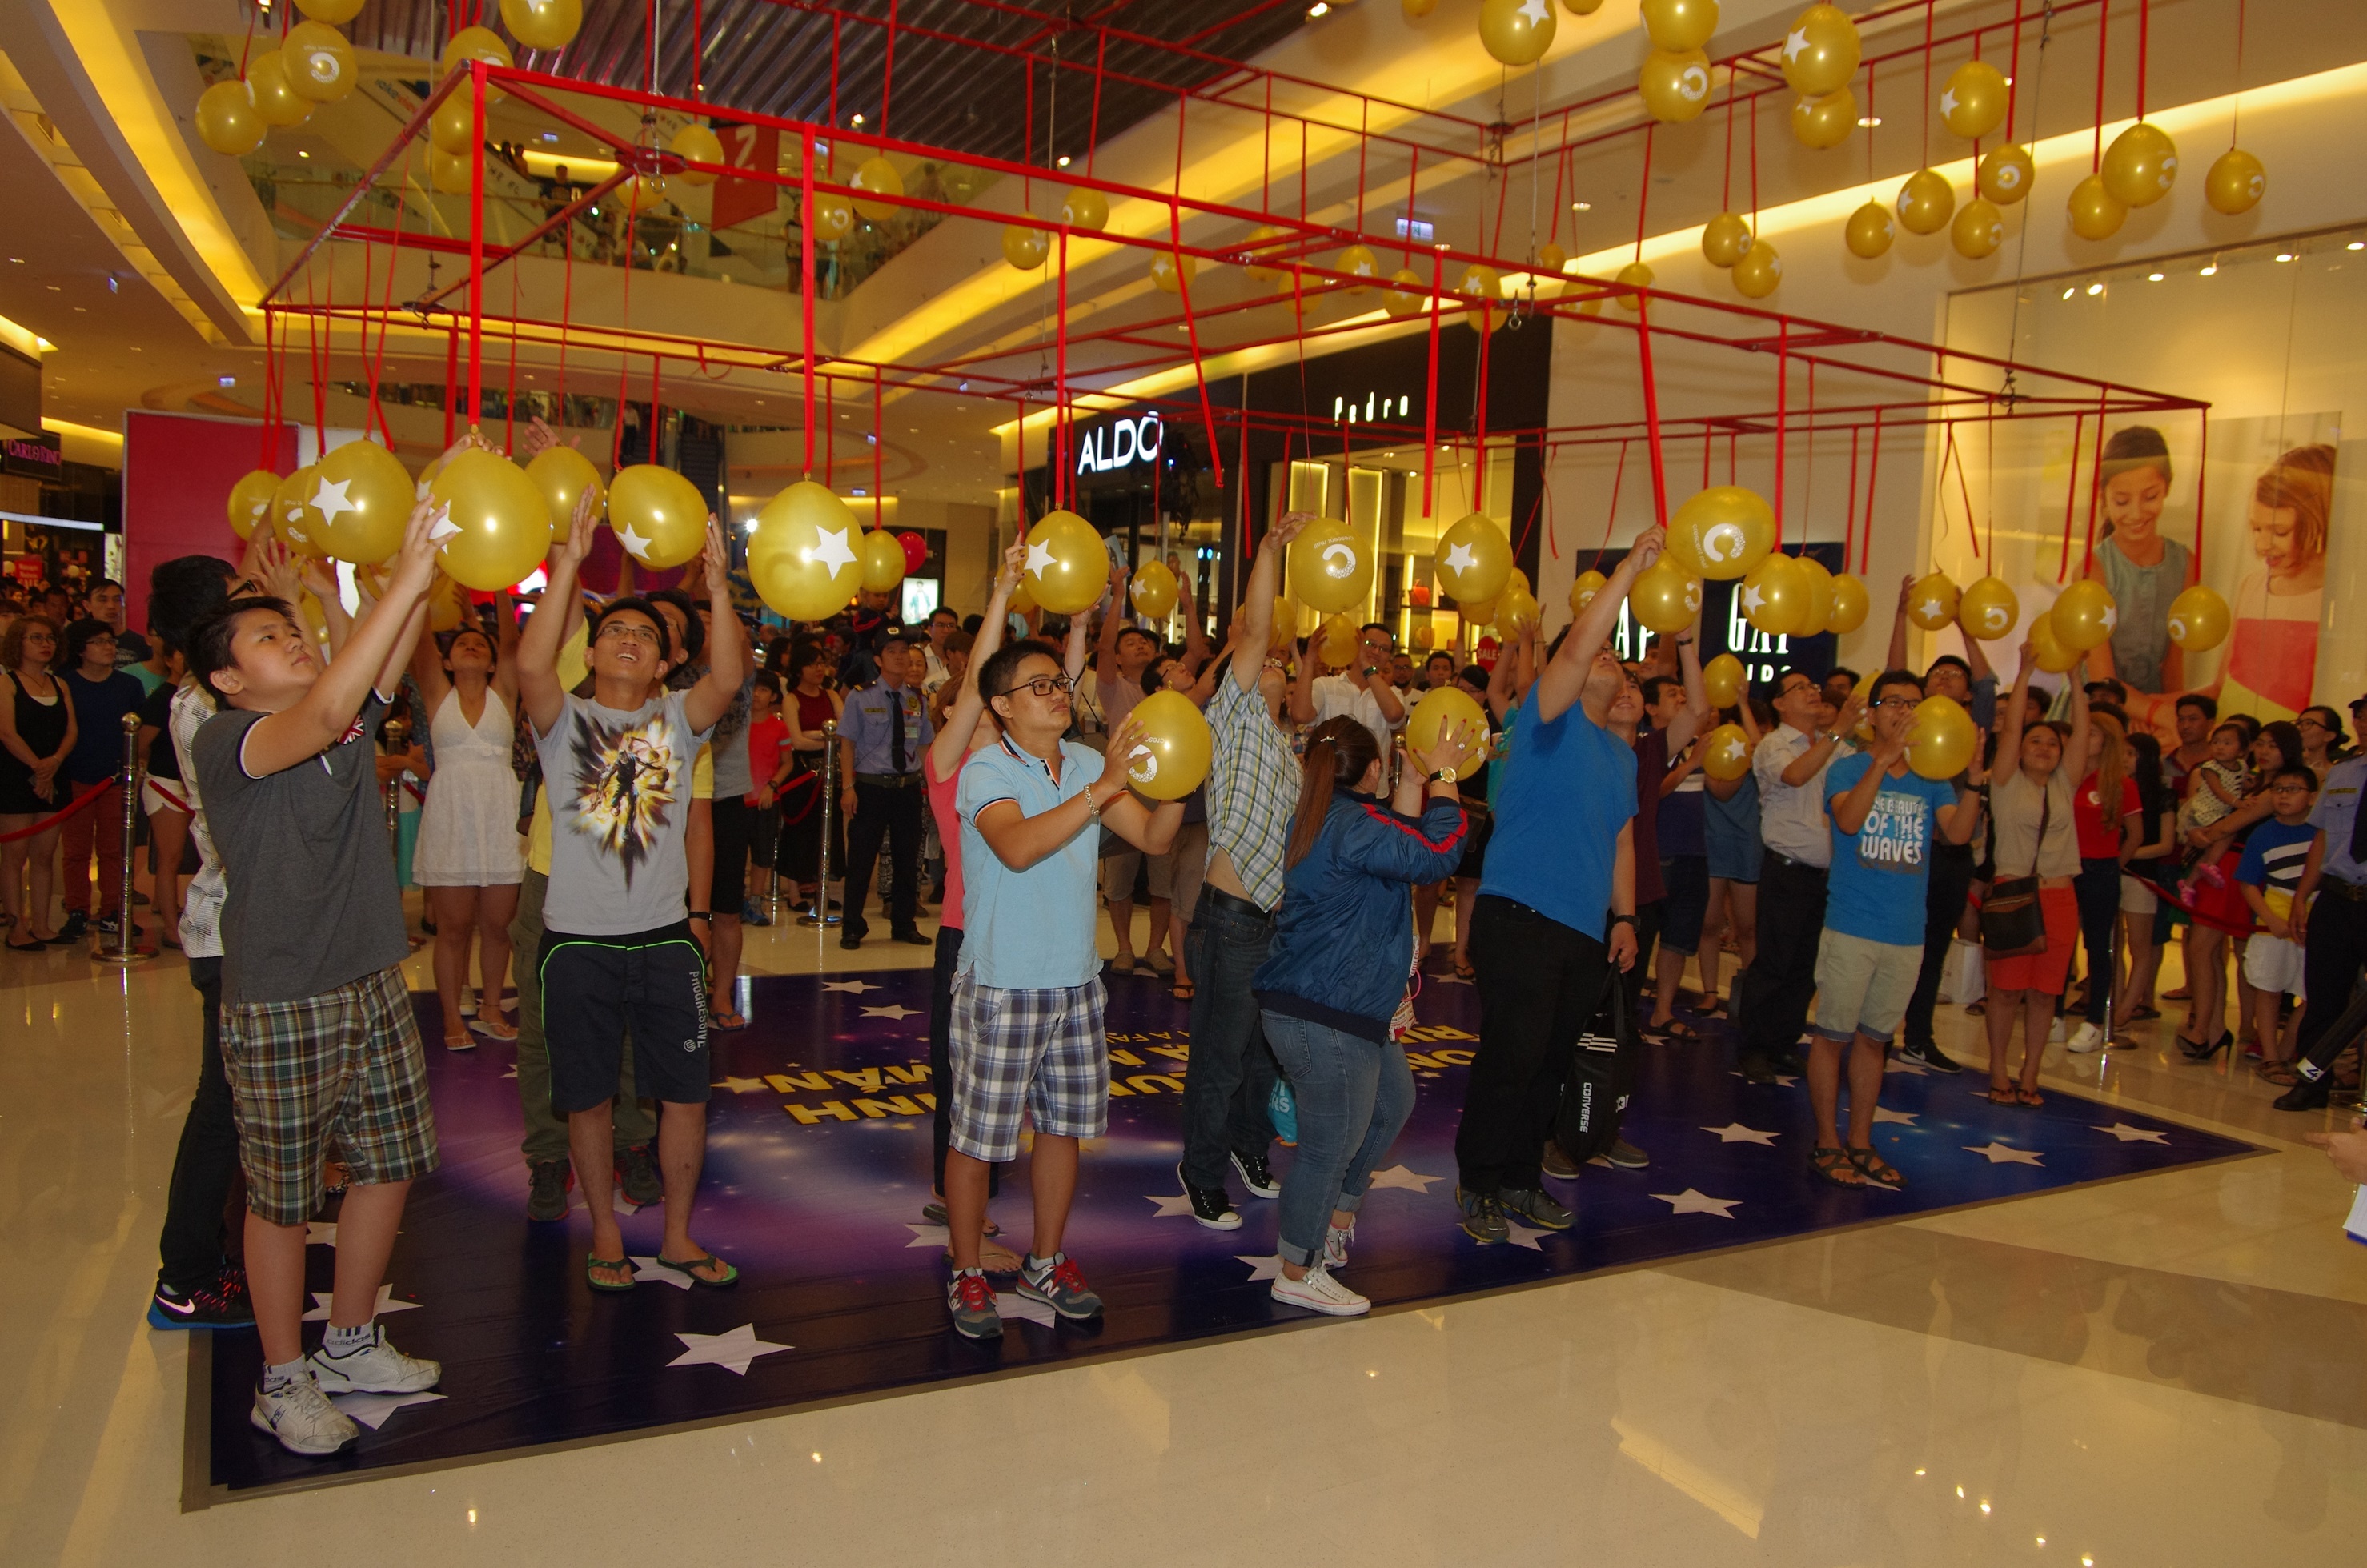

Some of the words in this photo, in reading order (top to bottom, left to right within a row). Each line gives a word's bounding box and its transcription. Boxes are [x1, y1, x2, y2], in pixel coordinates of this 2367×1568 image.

[1077, 410, 1164, 476] ALDO
[1313, 539, 1327, 549] mall
[1327, 535, 1354, 544] crescent
[1477, 648, 1498, 661] SALE
[1864, 810, 1889, 836] OF
[1894, 815, 1924, 840] THE
[1861, 834, 1924, 864] WAVES
[689, 970, 708, 1049] PROGRESSIVE
[783, 1092, 937, 1125] INH
[1579, 1081, 1593, 1133] CONVERSE
[326, 1333, 371, 1345] adidas
